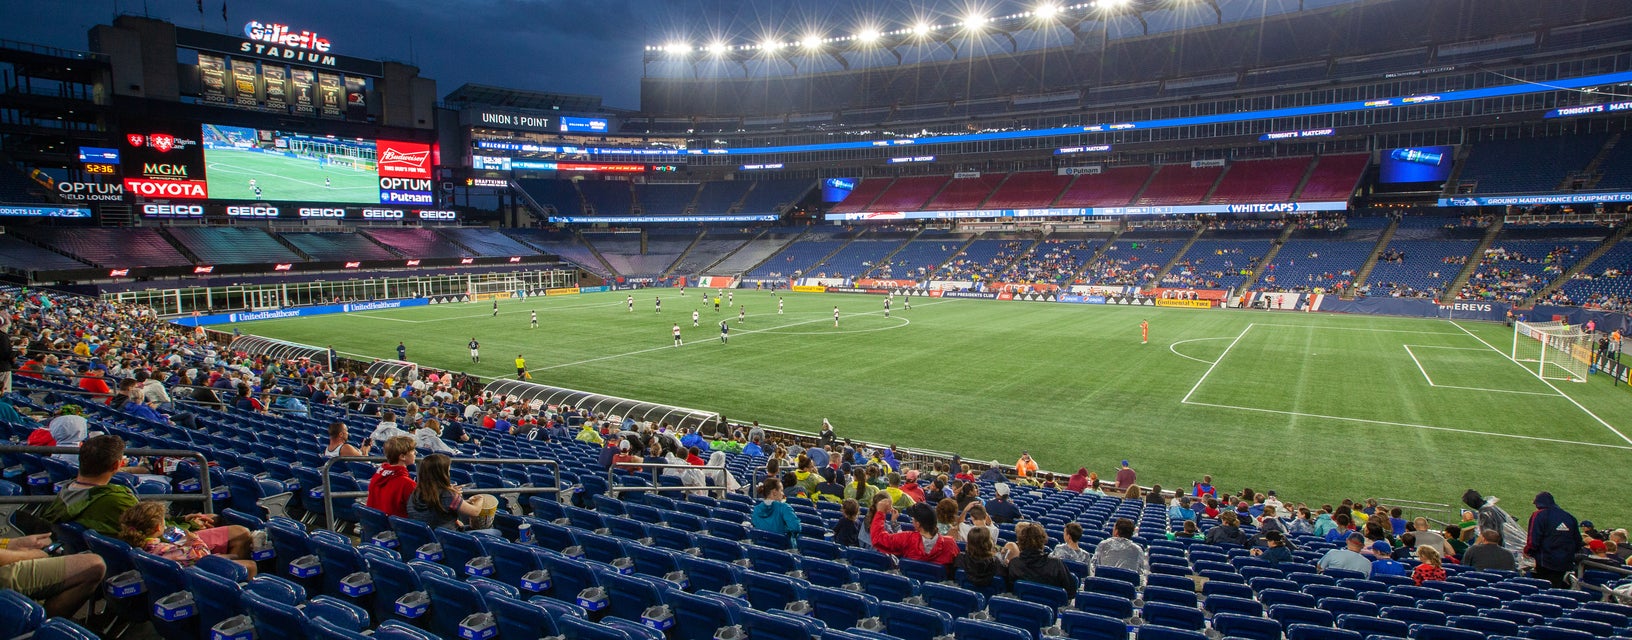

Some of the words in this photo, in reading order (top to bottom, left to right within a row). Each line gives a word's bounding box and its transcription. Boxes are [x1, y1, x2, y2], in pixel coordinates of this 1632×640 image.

[245, 21, 331, 52] Gillette
[240, 42, 336, 66] STADIUM
[1558, 106, 1604, 116] TONIGHT'S
[482, 113, 510, 124] UNION
[520, 117, 548, 128] POINT
[1267, 131, 1298, 139] TONIGHT'S
[174, 138, 196, 146] Pilgrim
[383, 151, 424, 162] Budweiser
[86, 164, 114, 174] 52:36
[144, 162, 188, 176] MGM
[58, 182, 124, 194] OPTUM
[128, 181, 205, 196] TOYOTA
[380, 177, 431, 191] OPTUM
[390, 192, 432, 202] Putnam
[1573, 194, 1618, 202] EQUIPMENT
[144, 204, 203, 215] GEICO
[227, 206, 279, 217] GEICO
[300, 208, 346, 218] GEICO
[1230, 204, 1294, 212] WHITECAPS
[363, 209, 404, 218] GEICO
[419, 211, 456, 219] GEICO
[350, 302, 400, 311] UnitedHealthcare
[238, 309, 300, 321] UnitedHealthcare
